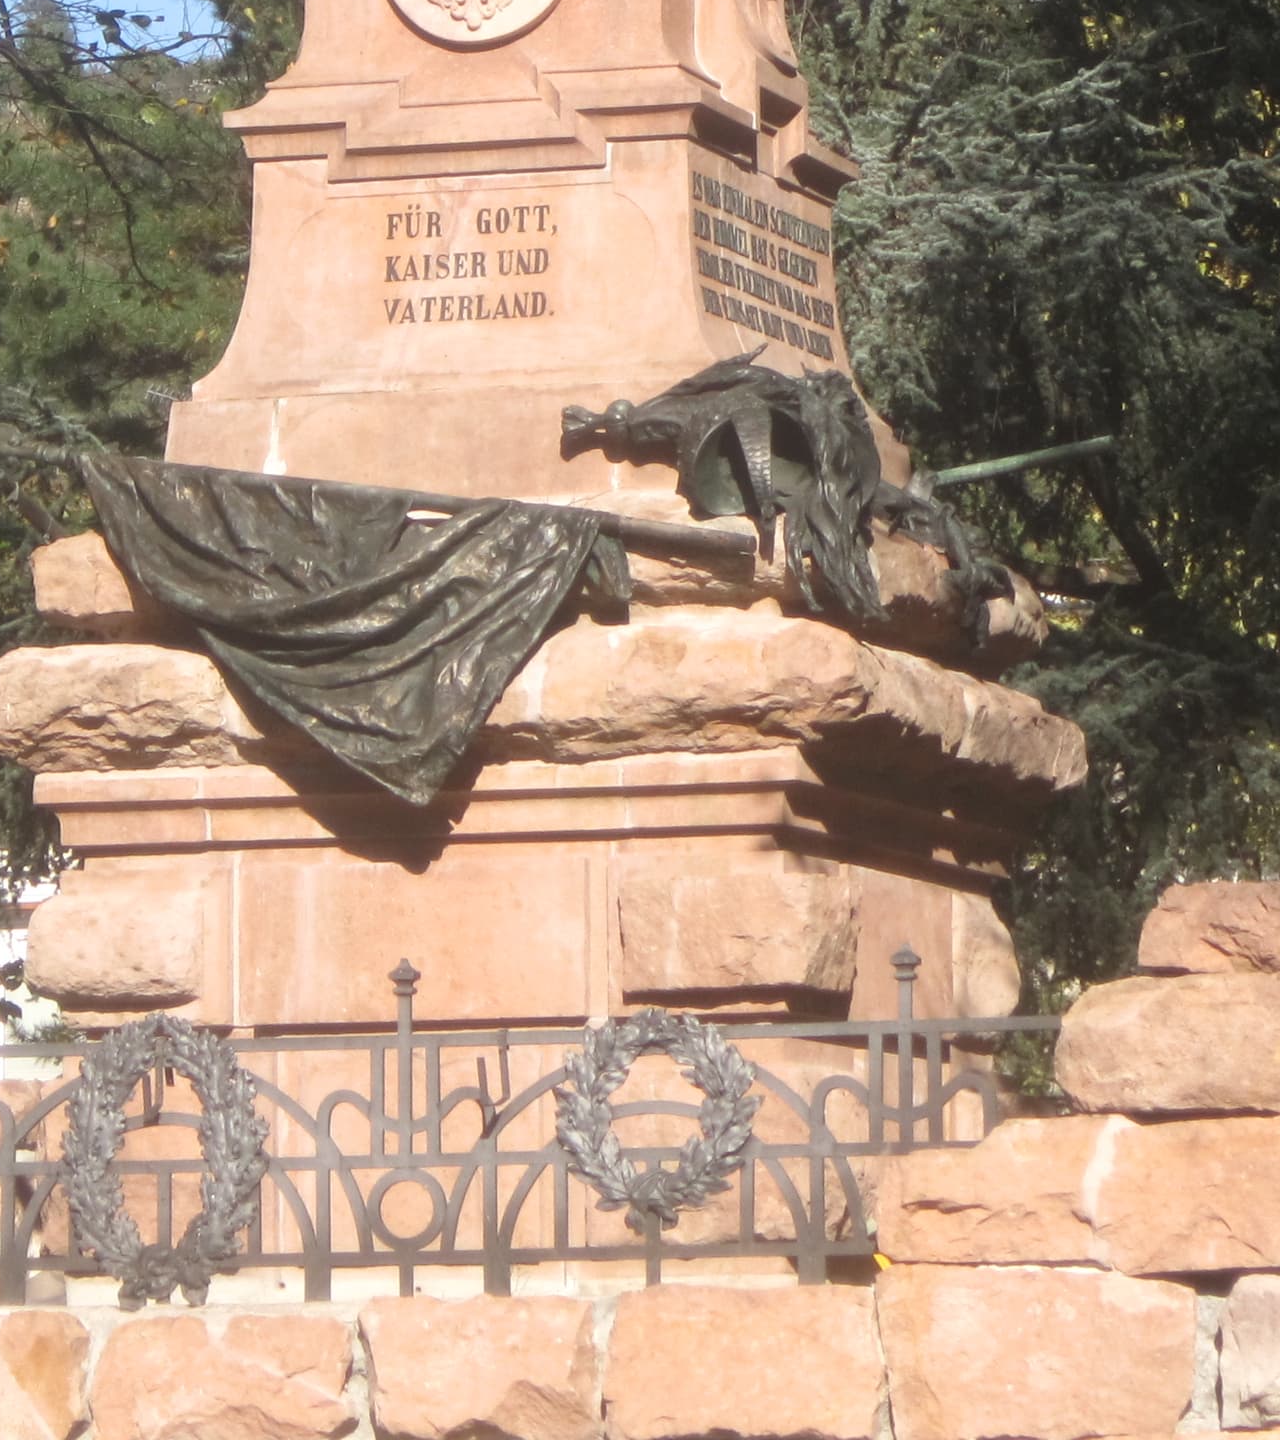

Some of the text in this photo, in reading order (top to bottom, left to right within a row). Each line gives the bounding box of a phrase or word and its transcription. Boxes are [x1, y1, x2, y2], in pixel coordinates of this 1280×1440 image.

[386, 204, 558, 240] FÜR GOTT,
[384, 248, 549, 282] KAISER UND
[383, 291, 555, 325] VATERLAND.
